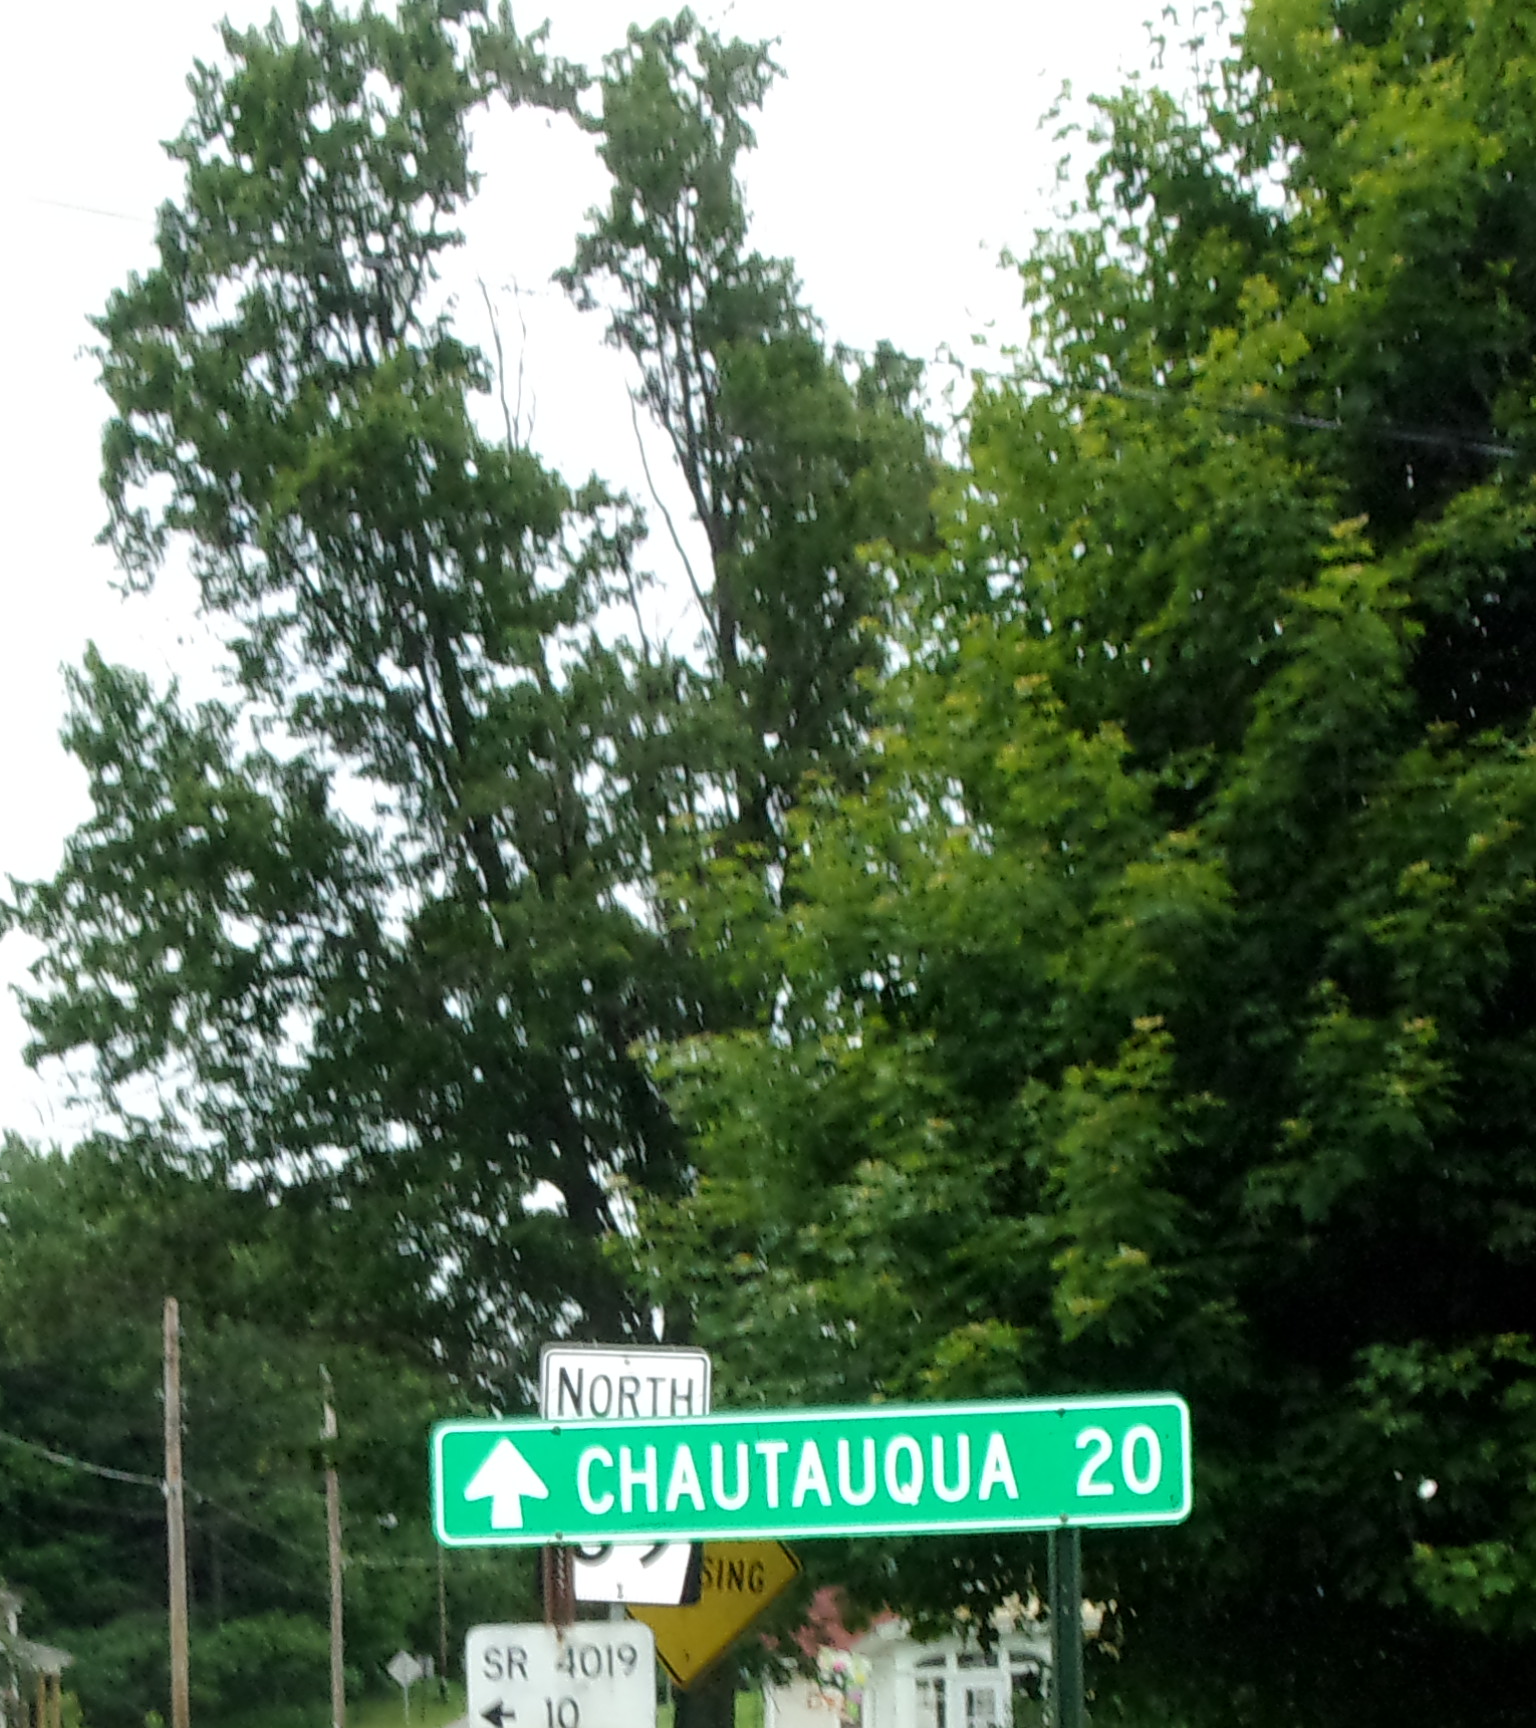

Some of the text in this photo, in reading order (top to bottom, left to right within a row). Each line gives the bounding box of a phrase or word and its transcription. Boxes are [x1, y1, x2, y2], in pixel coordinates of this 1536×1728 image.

[557, 1366, 694, 1419] NORTH
[576, 1423, 1162, 1516] CHAUTAUQUA 20
[482, 1643, 638, 1681] SR 4019
